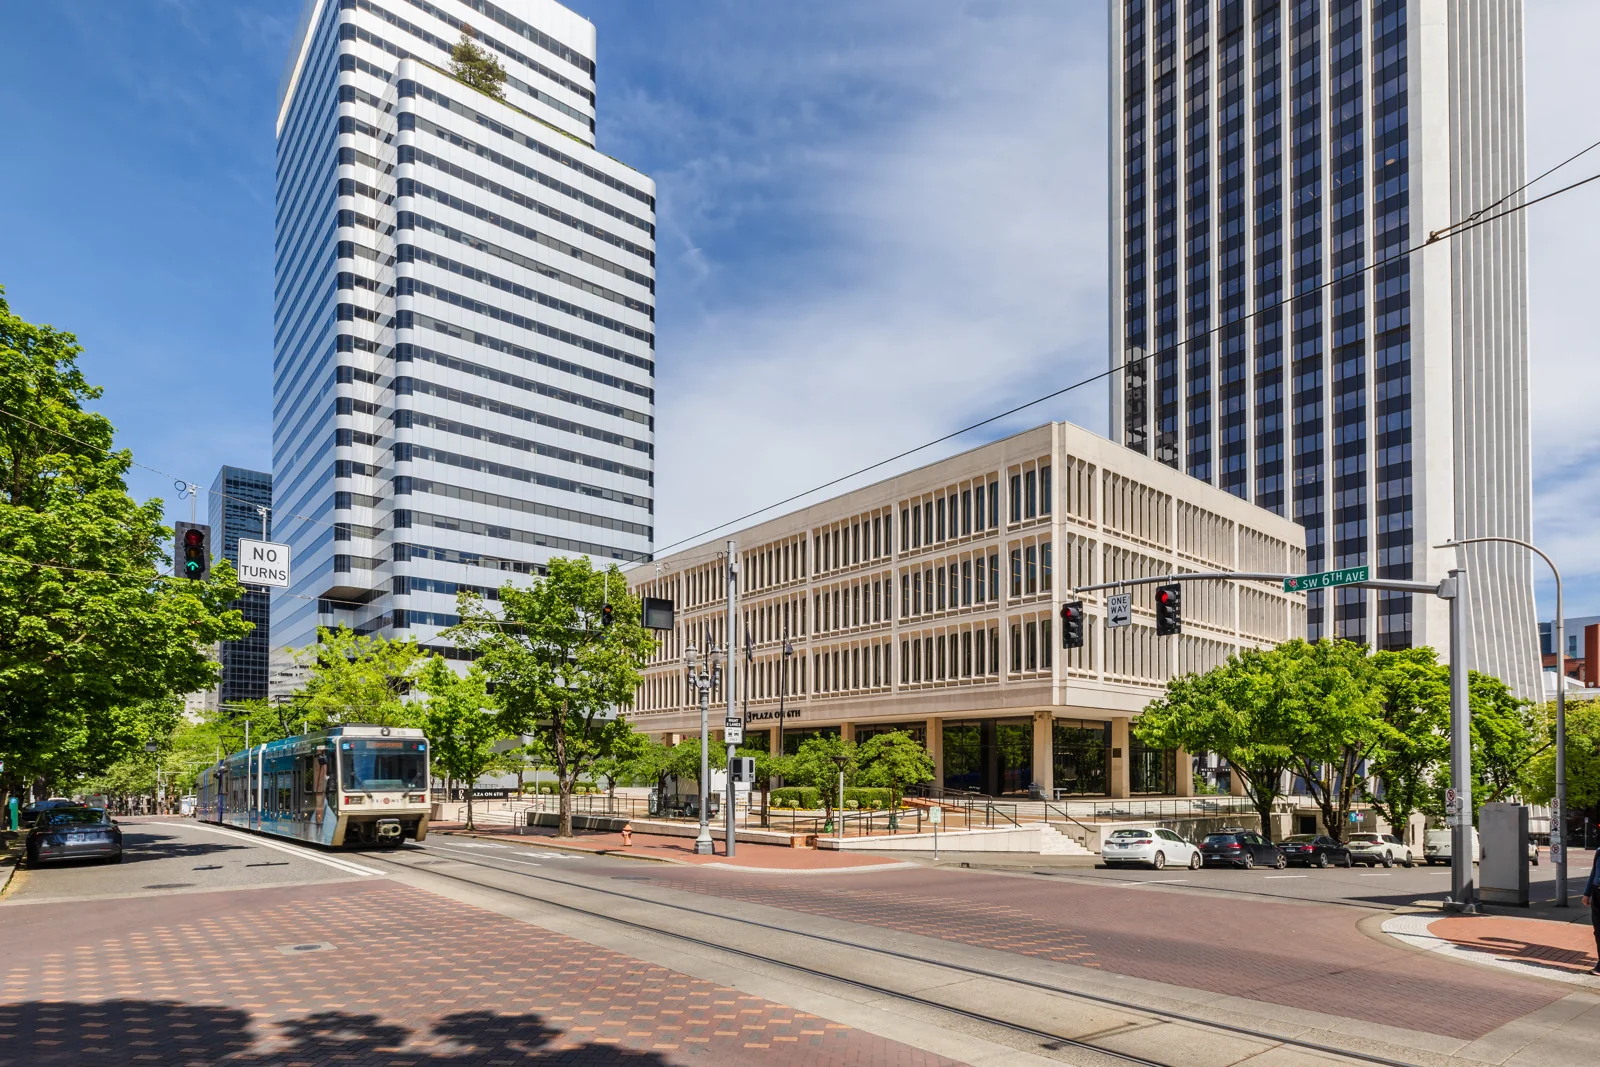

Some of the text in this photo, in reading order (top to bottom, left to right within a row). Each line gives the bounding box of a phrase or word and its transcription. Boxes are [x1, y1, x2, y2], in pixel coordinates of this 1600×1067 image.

[253, 546, 277, 562] NO
[242, 565, 286, 580] TURNS
[1302, 571, 1365, 589] SW 6TH AVE
[1111, 596, 1127, 605] ONE
[1111, 605, 1127, 614] WAY
[752, 711, 773, 720] PLAZA
[786, 709, 801, 718] 6TH
